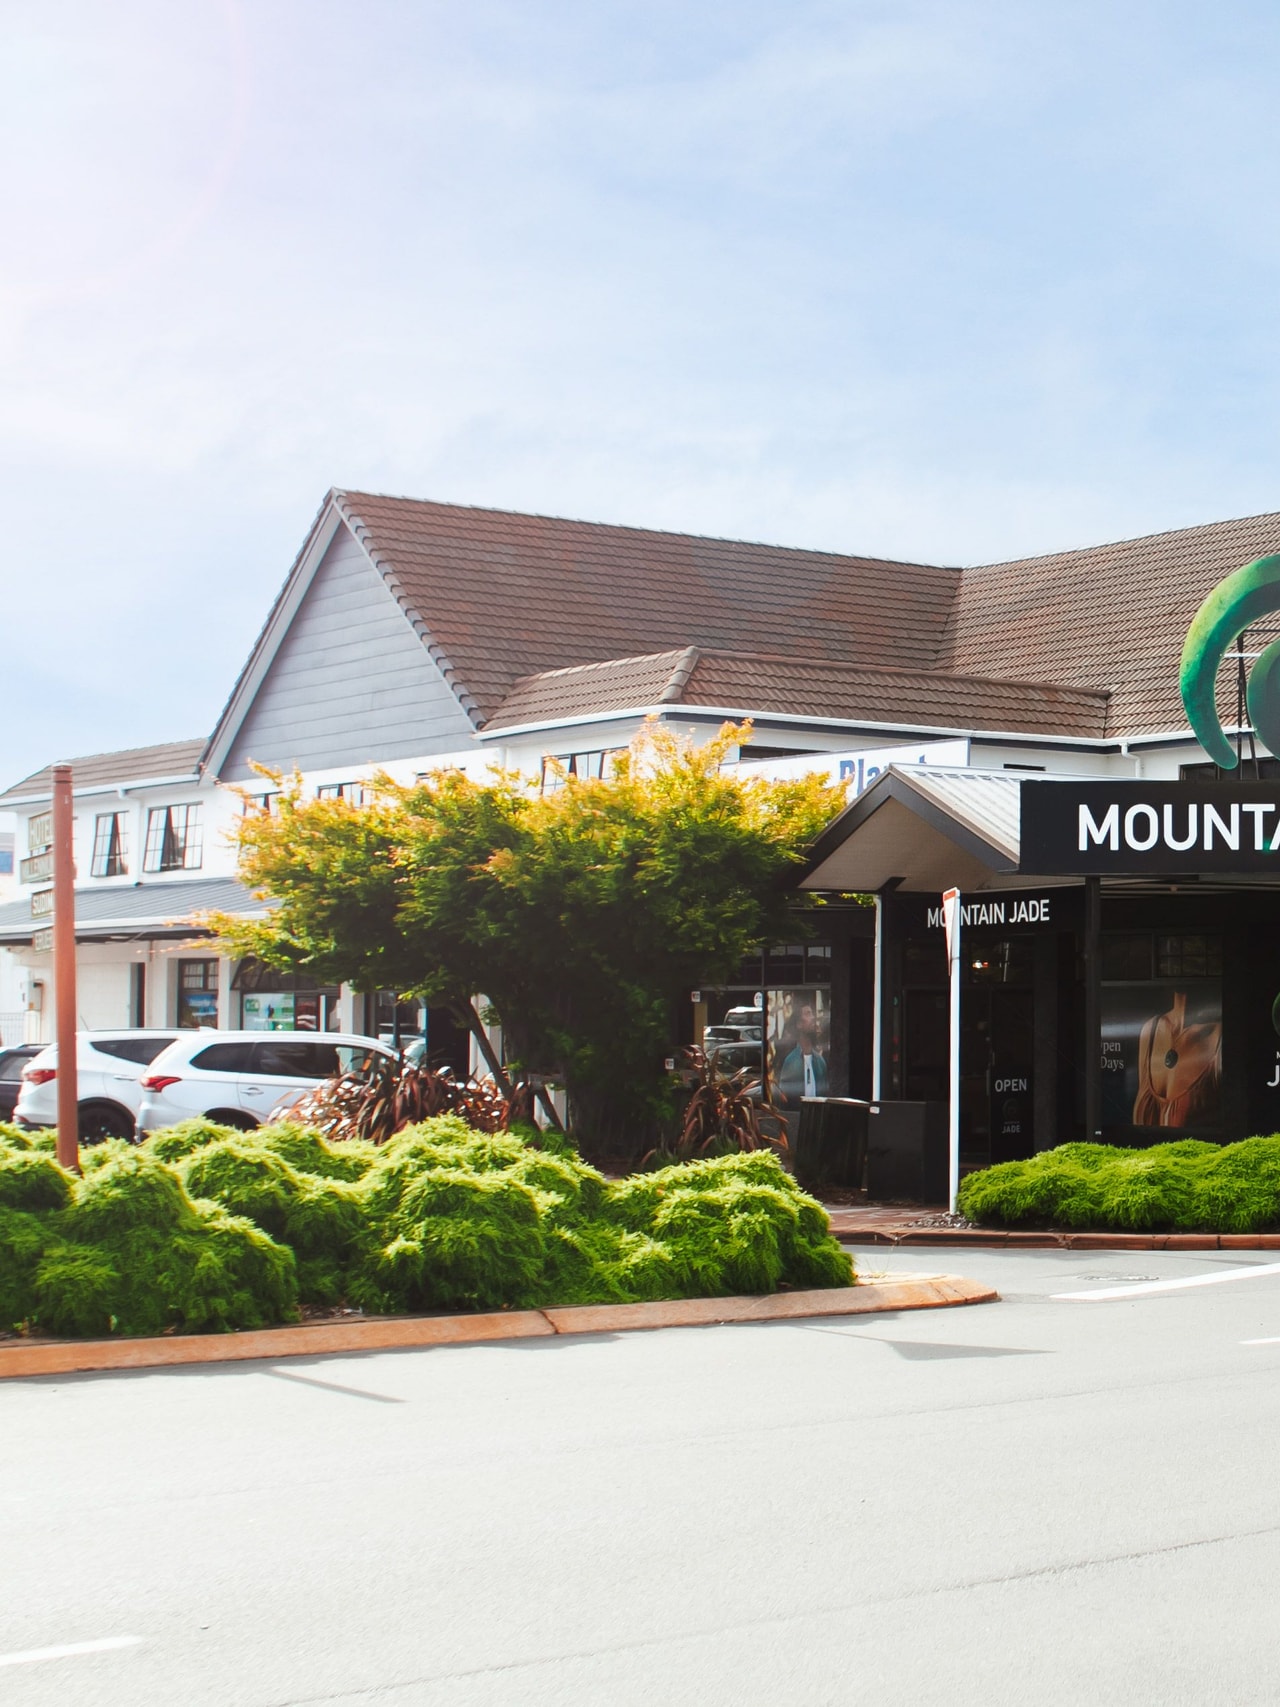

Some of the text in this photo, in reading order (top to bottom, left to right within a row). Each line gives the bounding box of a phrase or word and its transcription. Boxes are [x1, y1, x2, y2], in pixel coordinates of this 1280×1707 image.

[927, 899, 1050, 928] MONTAIN JADE
[1101, 1042, 1121, 1055] pen
[1101, 1056, 1125, 1072] Days
[995, 1079, 1027, 1092] OPEN
[1002, 1125, 1021, 1134] JADE
